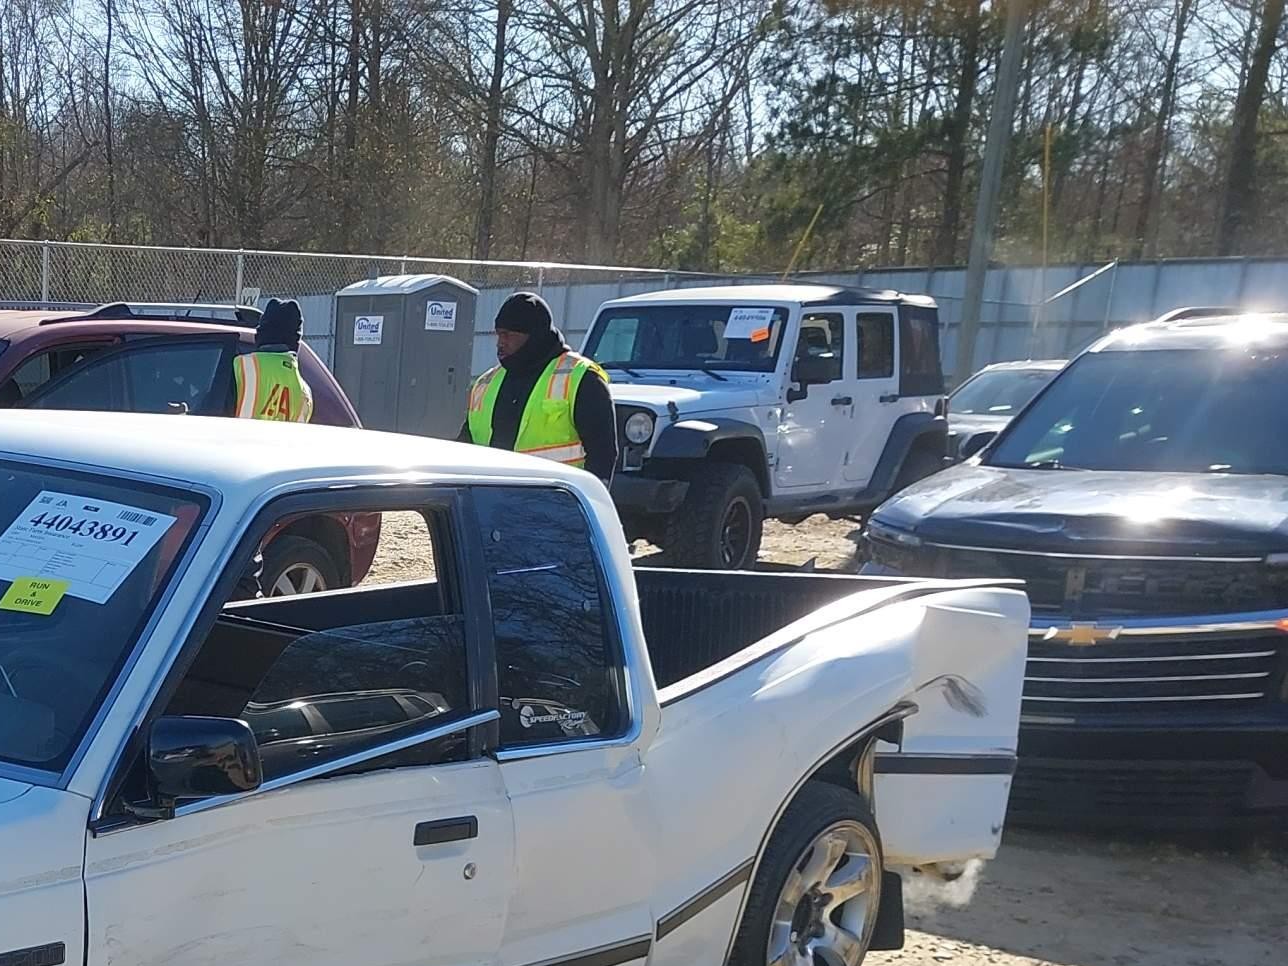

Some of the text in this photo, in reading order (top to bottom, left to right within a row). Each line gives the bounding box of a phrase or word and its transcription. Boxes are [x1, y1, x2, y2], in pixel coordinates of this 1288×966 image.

[431, 306, 453, 316] United
[358, 321, 380, 330] United
[29, 511, 140, 547] 44043891
[29, 581, 50, 590] RUN
[14, 598, 43, 607] DRIVE
